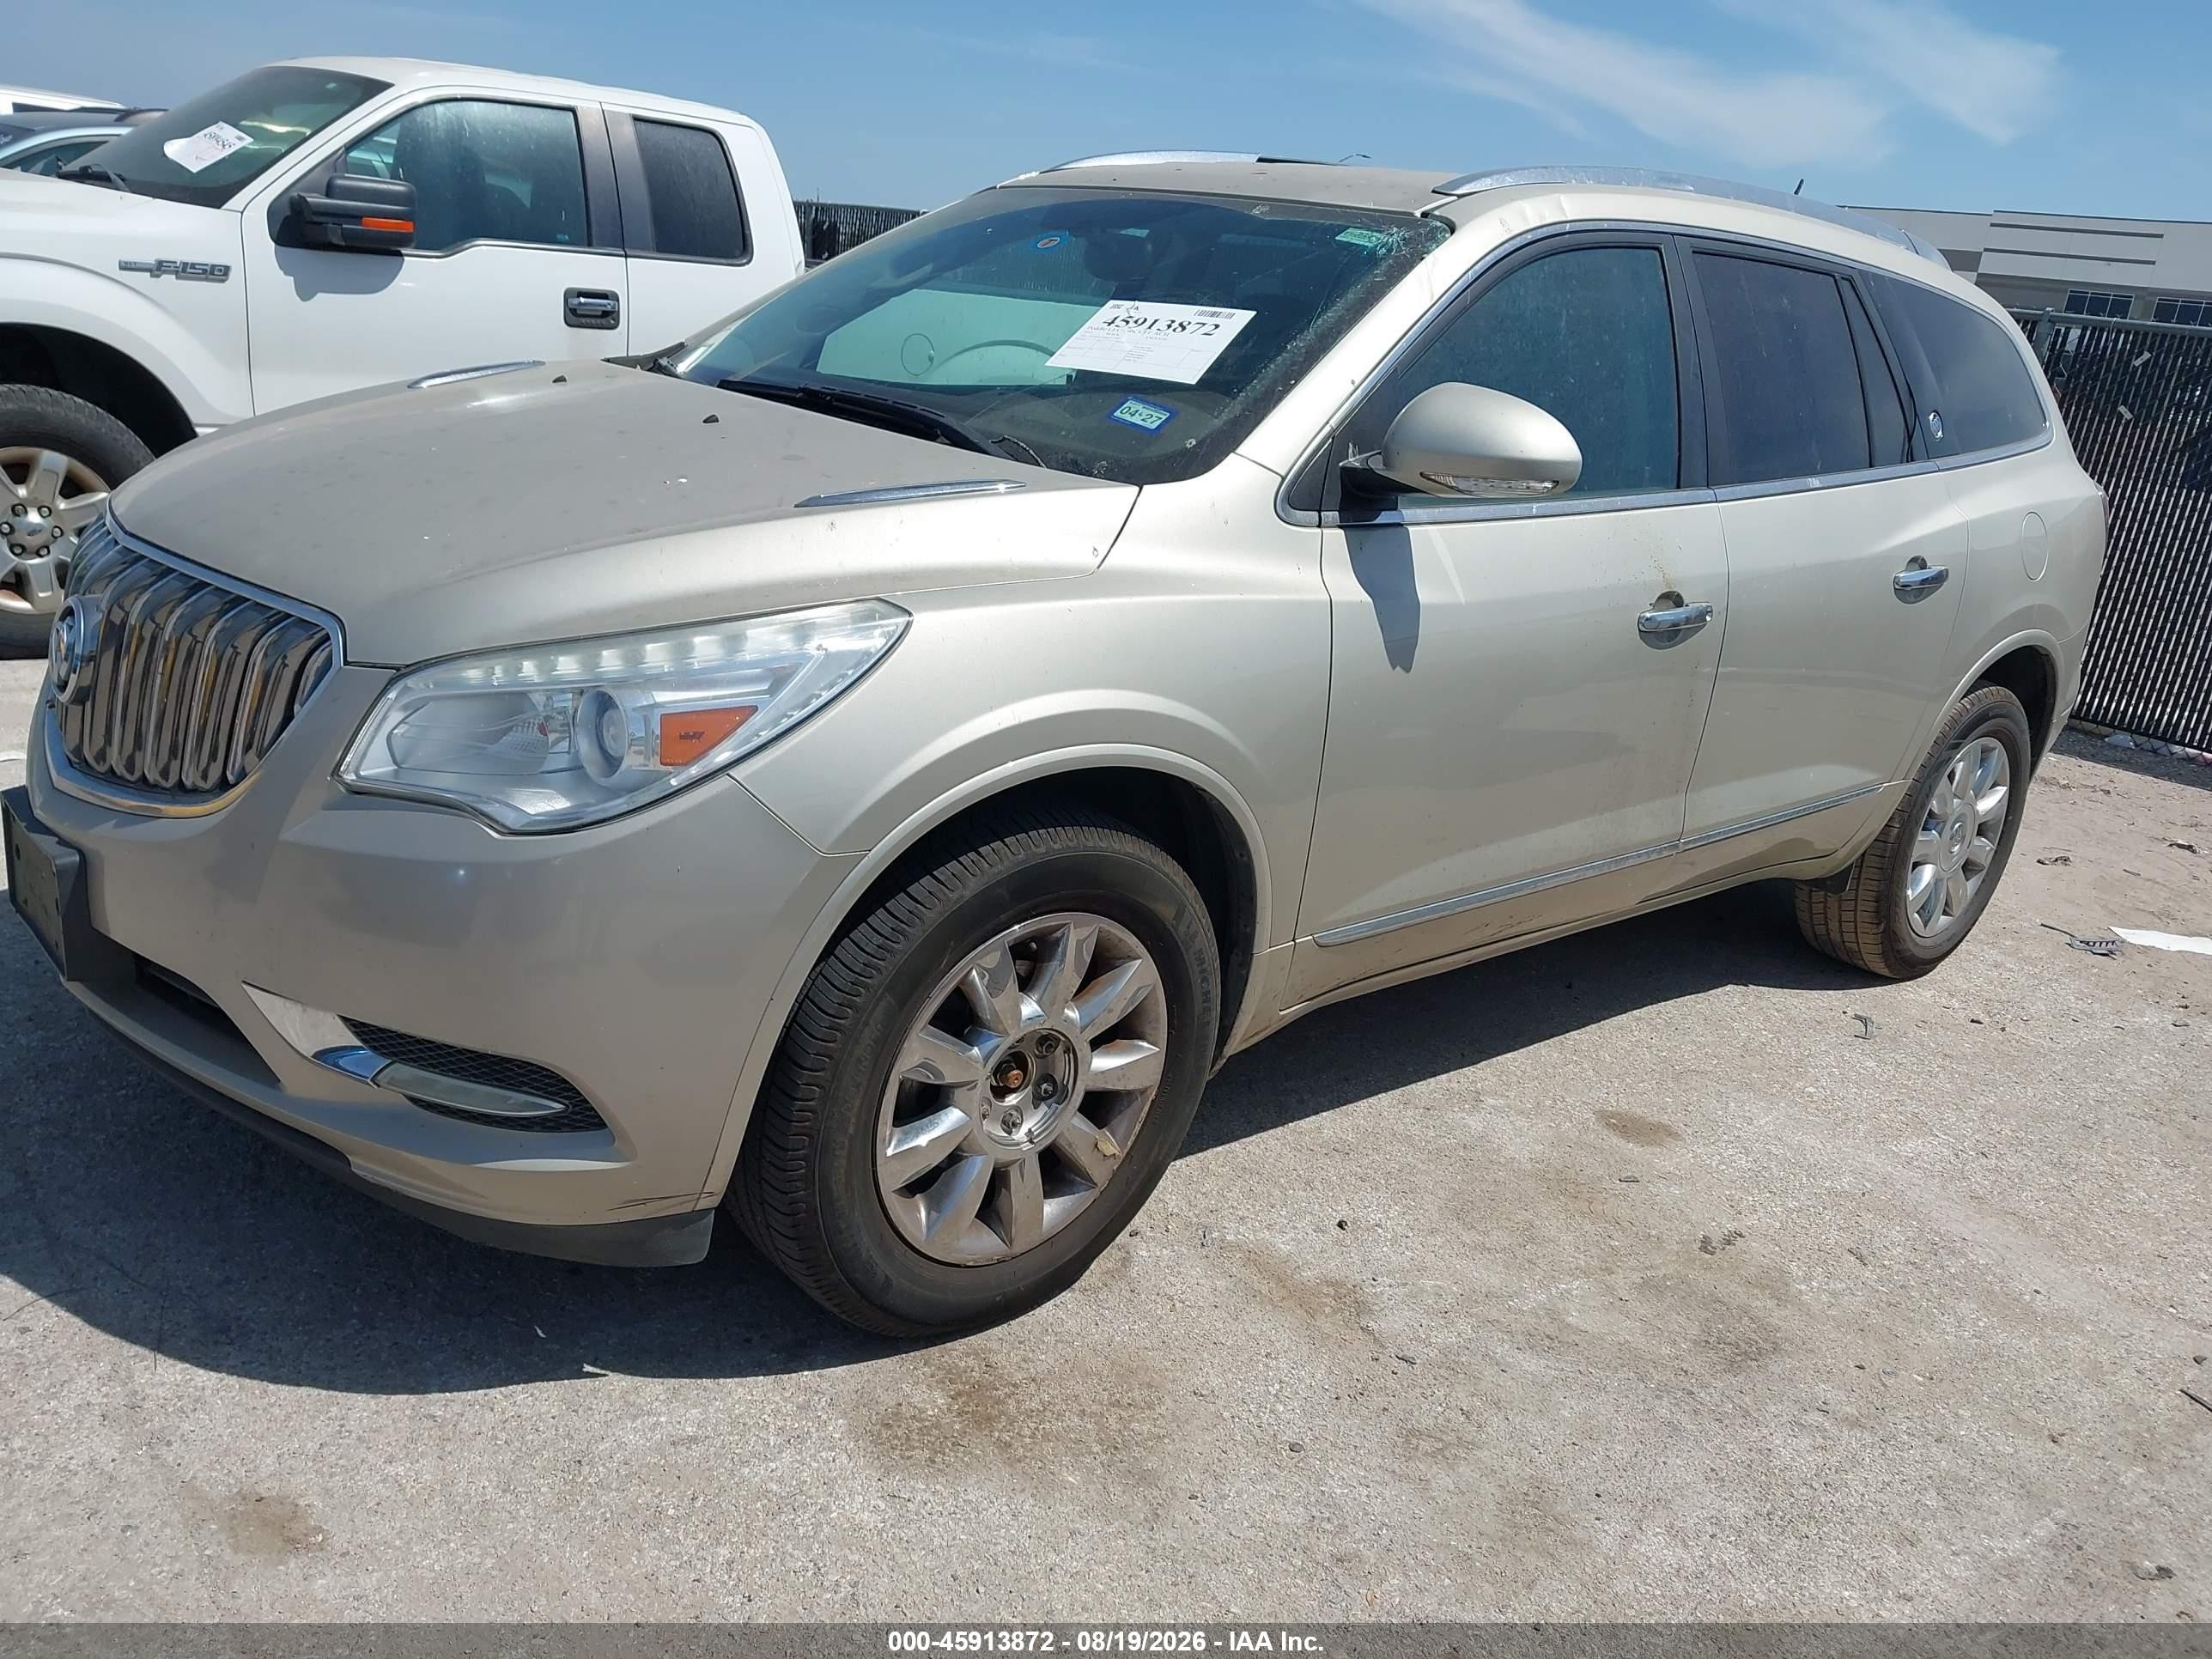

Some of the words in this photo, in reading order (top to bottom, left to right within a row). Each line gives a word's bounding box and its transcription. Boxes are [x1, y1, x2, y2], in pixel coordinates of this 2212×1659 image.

[155, 258, 231, 281] F-150
[1102, 314, 1222, 337] 45913872
[1119, 406, 1139, 417] 04
[1140, 413, 1164, 424] 27
